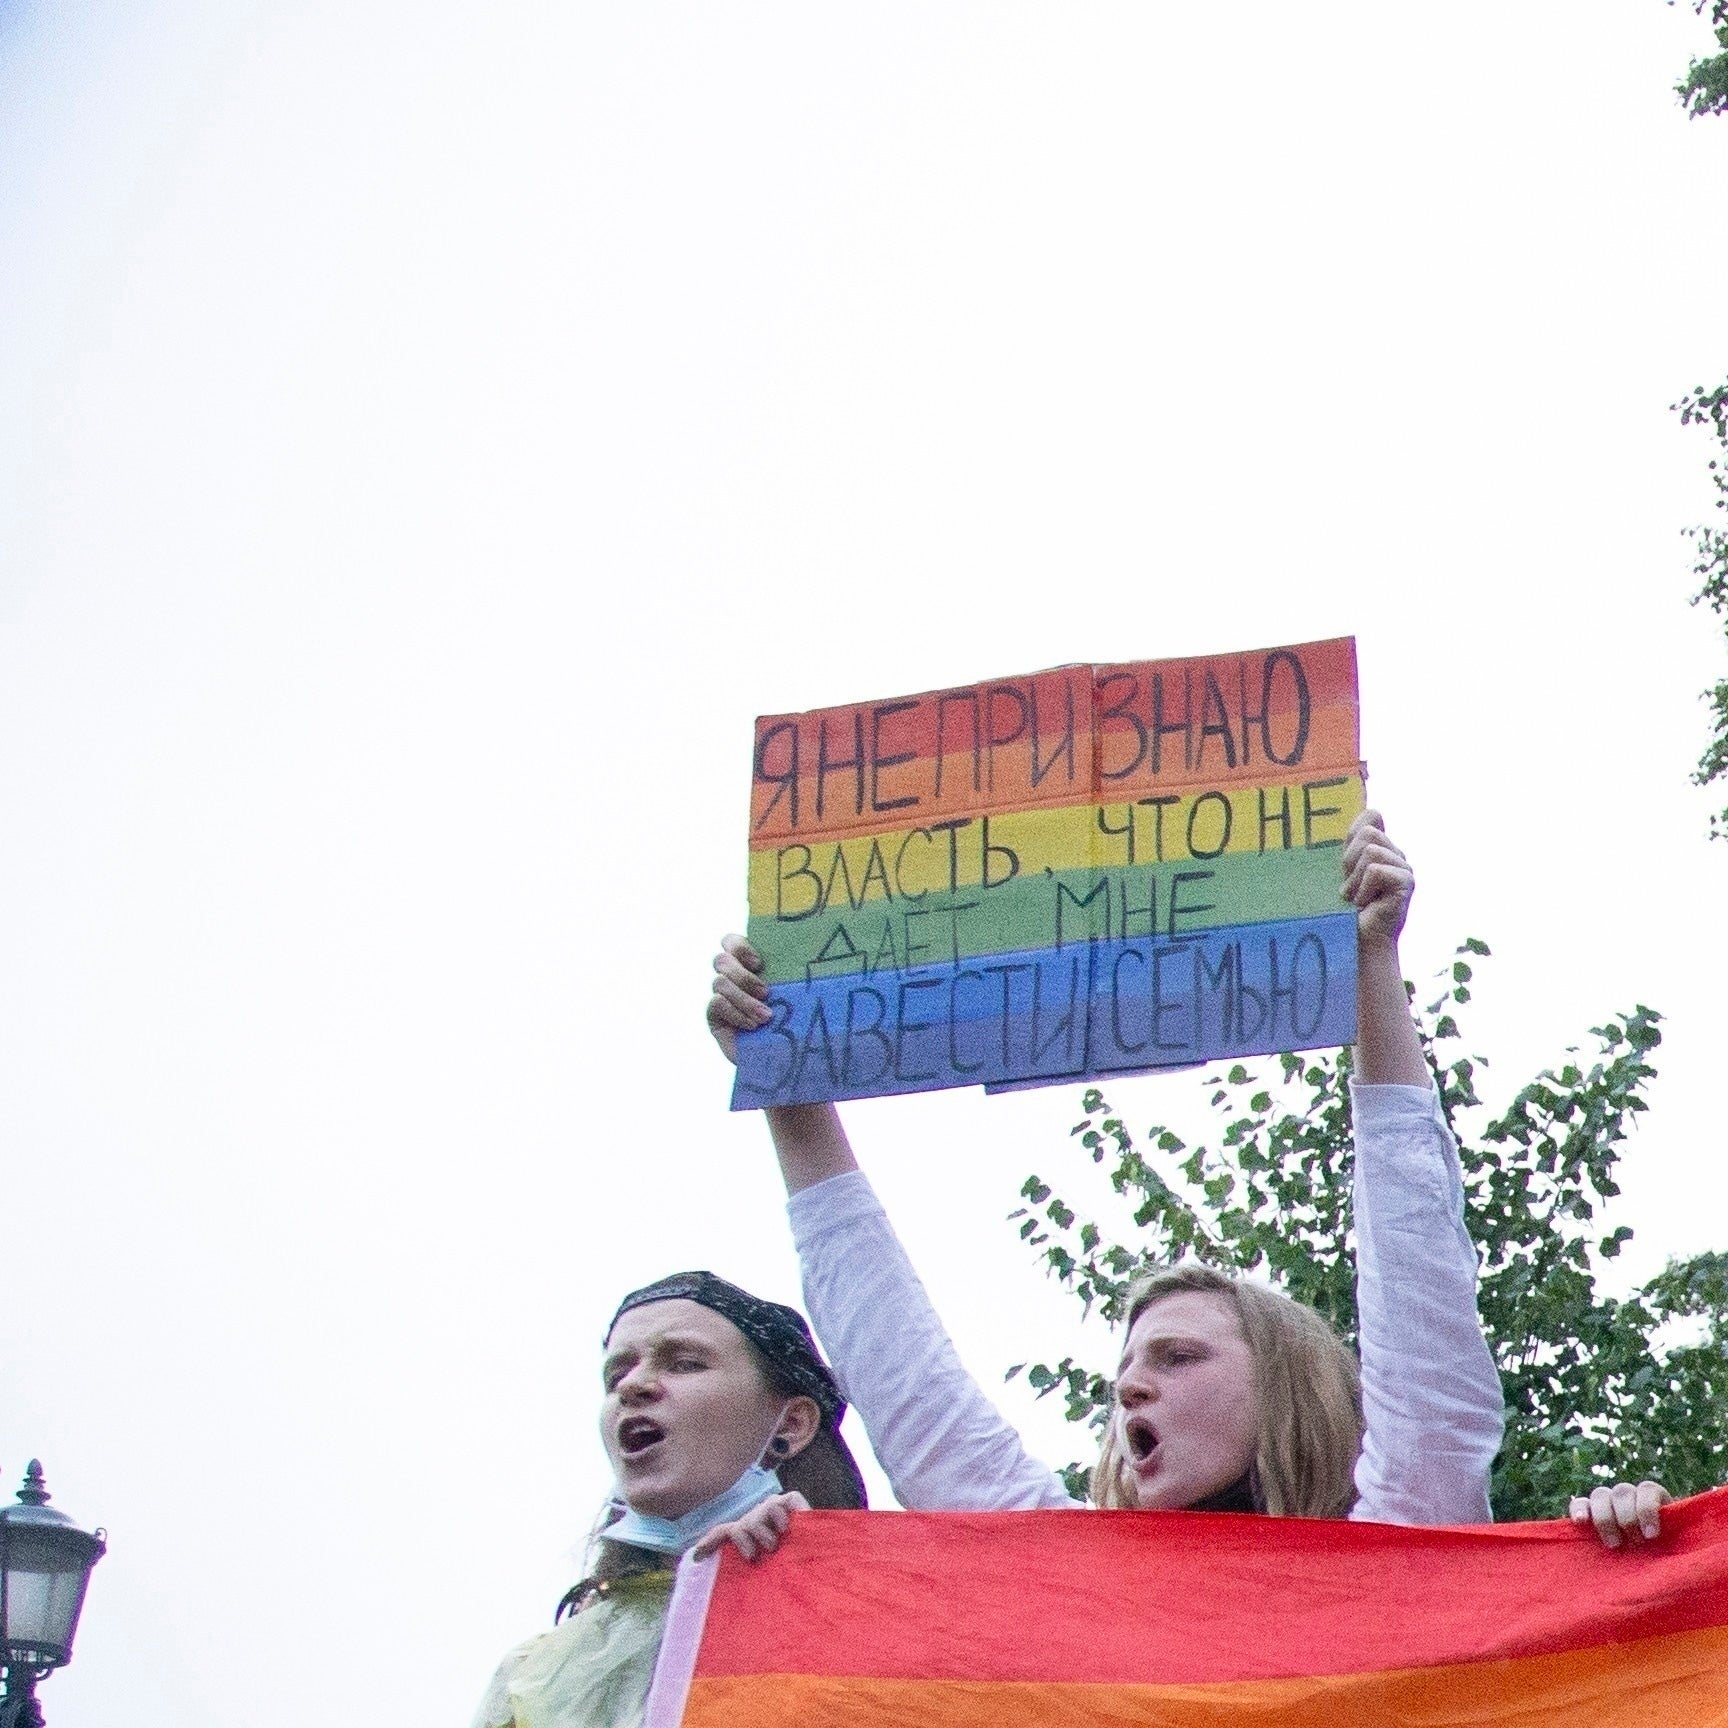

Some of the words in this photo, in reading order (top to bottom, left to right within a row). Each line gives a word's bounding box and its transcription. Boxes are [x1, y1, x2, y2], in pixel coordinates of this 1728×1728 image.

[753, 721, 800, 830] Я
[815, 701, 920, 816] НЕ
[933, 651, 1310, 798] ПРИЗНАЮ
[1098, 790, 1233, 870] ЧТО
[1258, 777, 1349, 857] НЕ
[806, 903, 980, 989] ДАЕТ
[1056, 870, 1217, 956] МНЕ
[747, 954, 1082, 1096] ЗАВЕСТИ
[1111, 932, 1328, 1054] СЕМЬЮ
